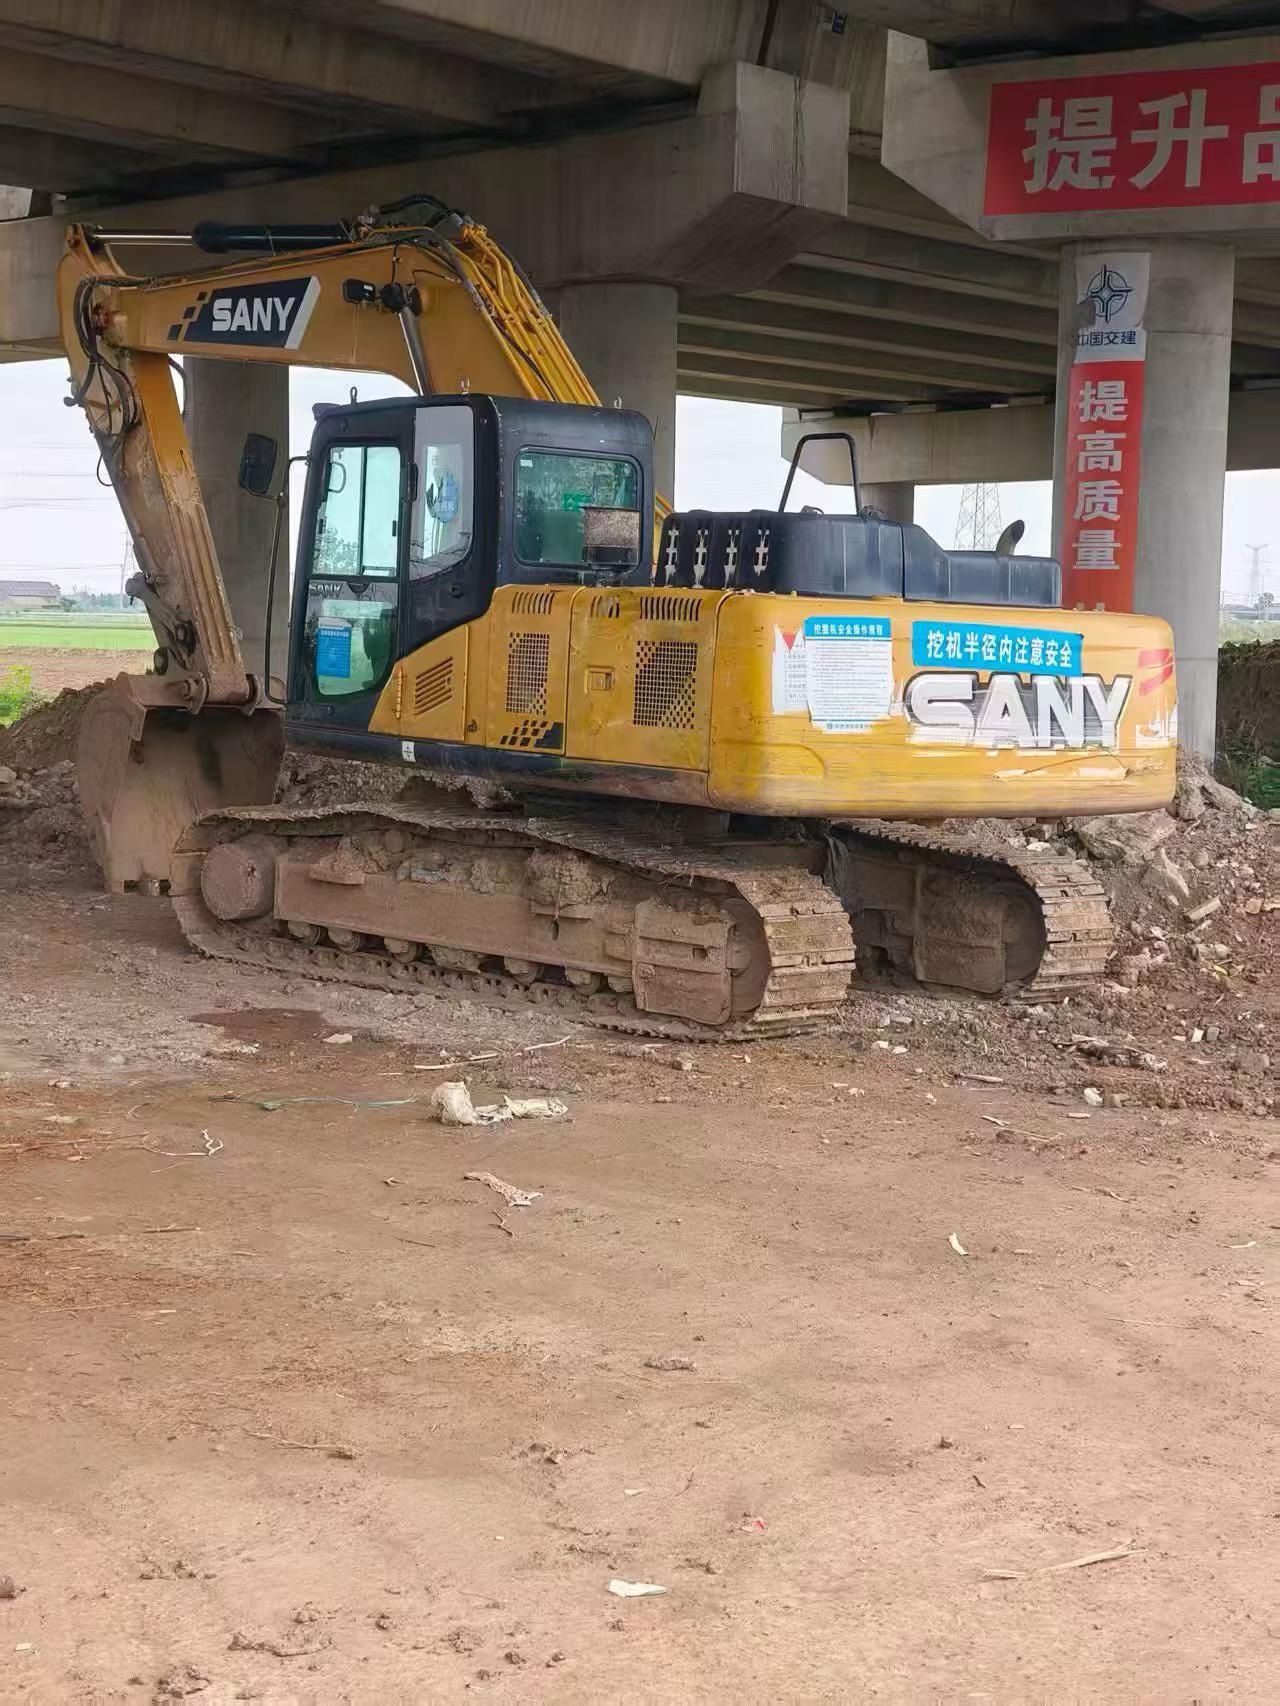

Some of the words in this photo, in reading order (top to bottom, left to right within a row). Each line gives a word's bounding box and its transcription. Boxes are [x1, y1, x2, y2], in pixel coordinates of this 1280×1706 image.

[212, 297, 295, 331] SANY
[1077, 331, 1136, 347] 中国交建
[1072, 380, 1128, 612] 提高质量
[927, 629, 1072, 668] 挖机半径内注意安全
[904, 671, 1132, 749] SANY
